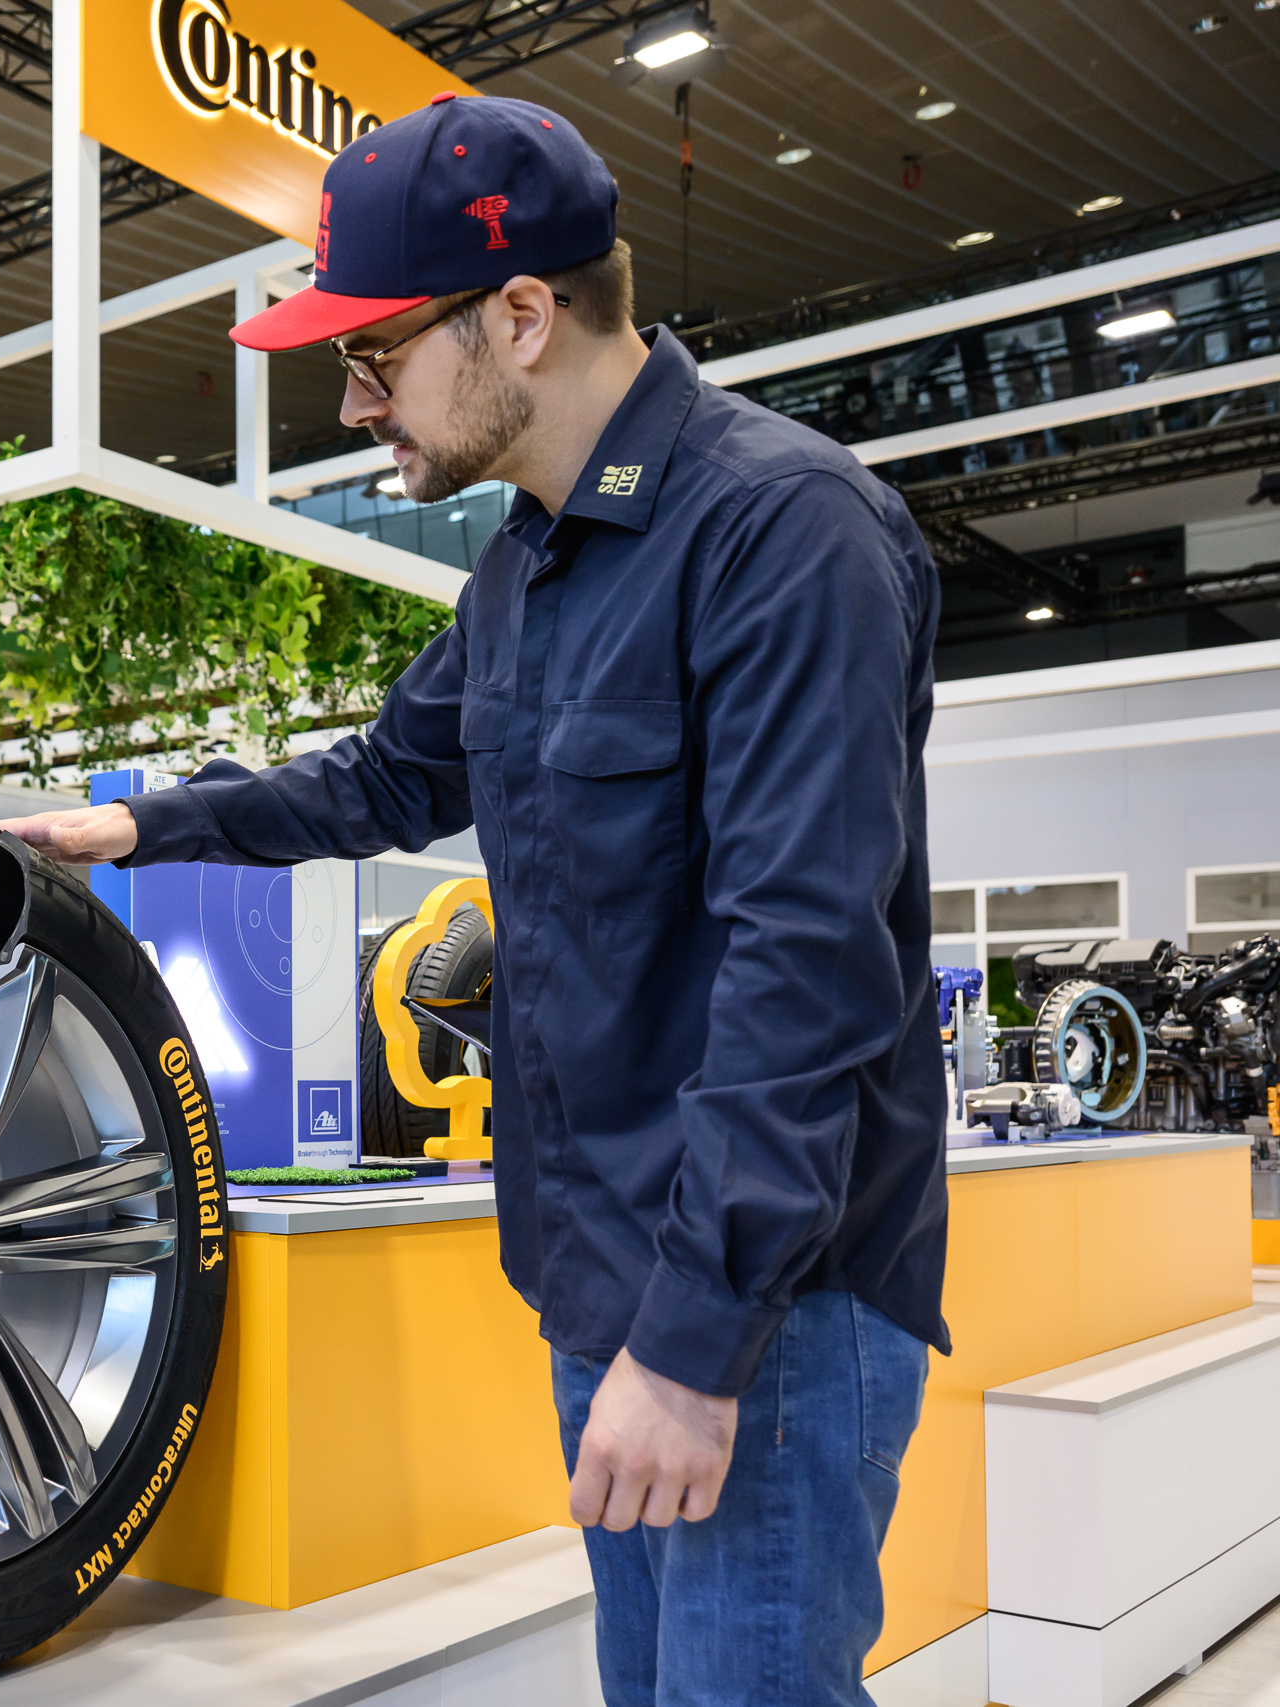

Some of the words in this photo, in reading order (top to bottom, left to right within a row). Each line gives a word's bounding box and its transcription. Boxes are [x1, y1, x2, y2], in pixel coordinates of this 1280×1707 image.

[615, 466, 640, 494] BLG
[154, 775, 166, 784] ATE
[159, 1037, 224, 1239] Continental
[297, 1150, 328, 1158] Brakethrough
[329, 1148, 353, 1156] Technology
[112, 1403, 198, 1550] UltraContact
[75, 1543, 114, 1595] NXT
